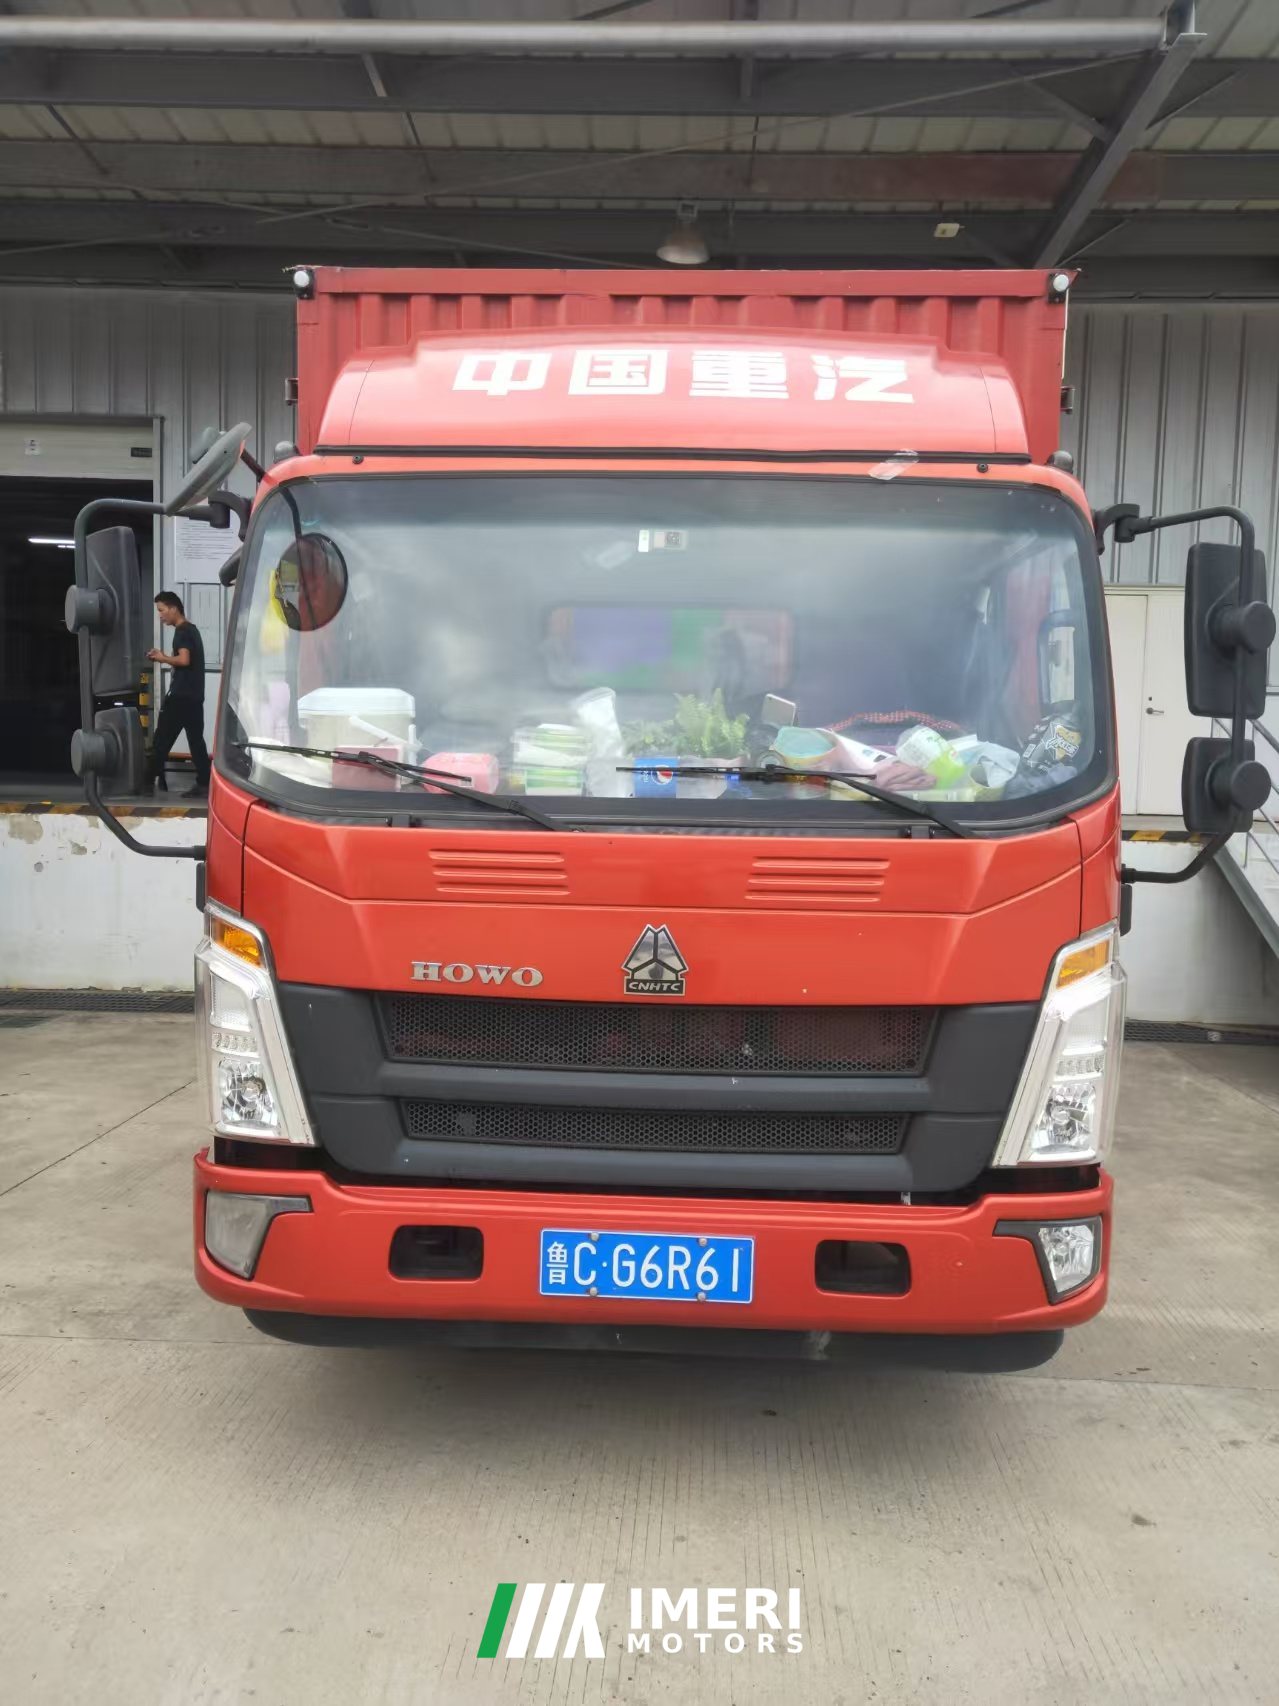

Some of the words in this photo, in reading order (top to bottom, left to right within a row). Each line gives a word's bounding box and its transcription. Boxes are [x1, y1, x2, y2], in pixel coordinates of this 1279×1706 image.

[452, 349, 915, 403] 中国重汽
[410, 961, 544, 987] HOWO
[628, 981, 681, 991] CNHTC
